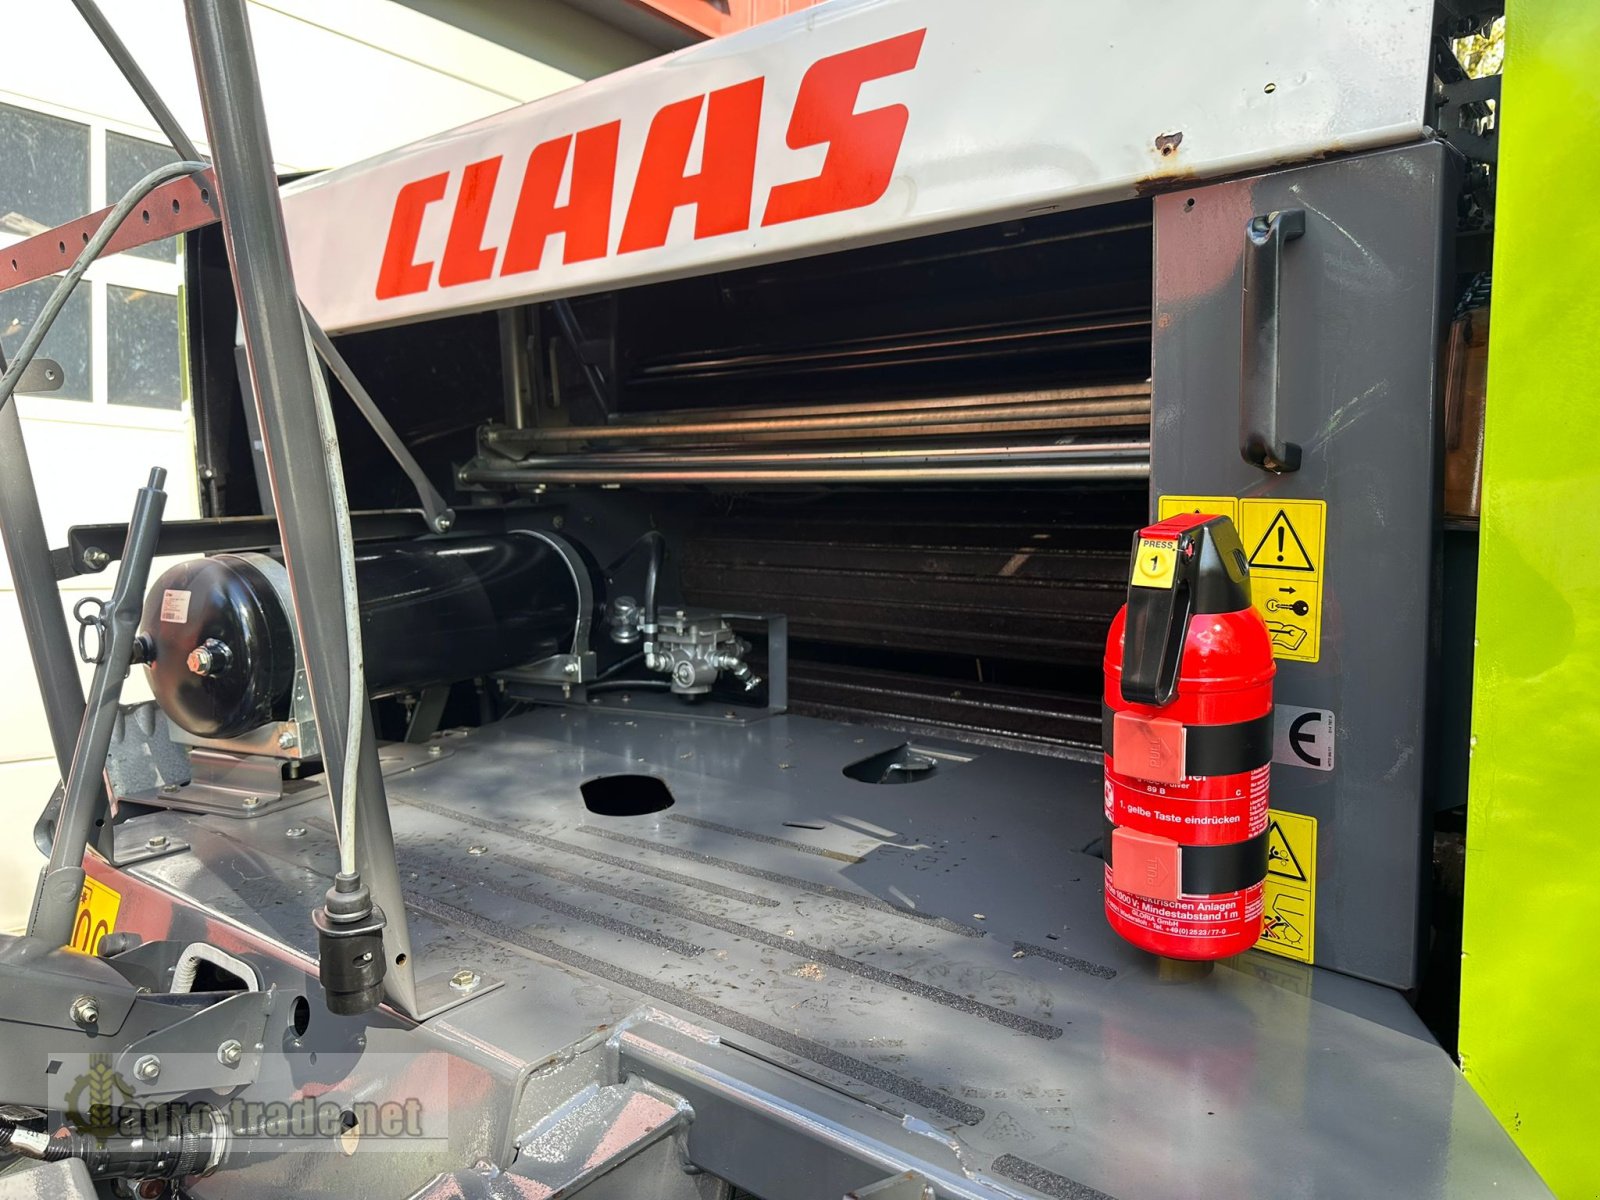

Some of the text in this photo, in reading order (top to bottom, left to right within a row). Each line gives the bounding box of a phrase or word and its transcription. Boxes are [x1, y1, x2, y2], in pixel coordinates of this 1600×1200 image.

[376, 27, 927, 300] CLAAS
[1143, 540, 1174, 549] PRESS
[1150, 556, 1159, 571] 1
[1149, 738, 1161, 768] PULL
[1147, 785, 1157, 793] 89
[1119, 800, 1240, 825] 1. gelbe Taste eindrücken
[1116, 890, 1131, 904] 1000
[1142, 903, 1221, 920] Mindestabstand
[1223, 911, 1228, 919] 1
[1197, 902, 1236, 912] Anlagen
[1131, 910, 1179, 927] GLORIA GmbH
